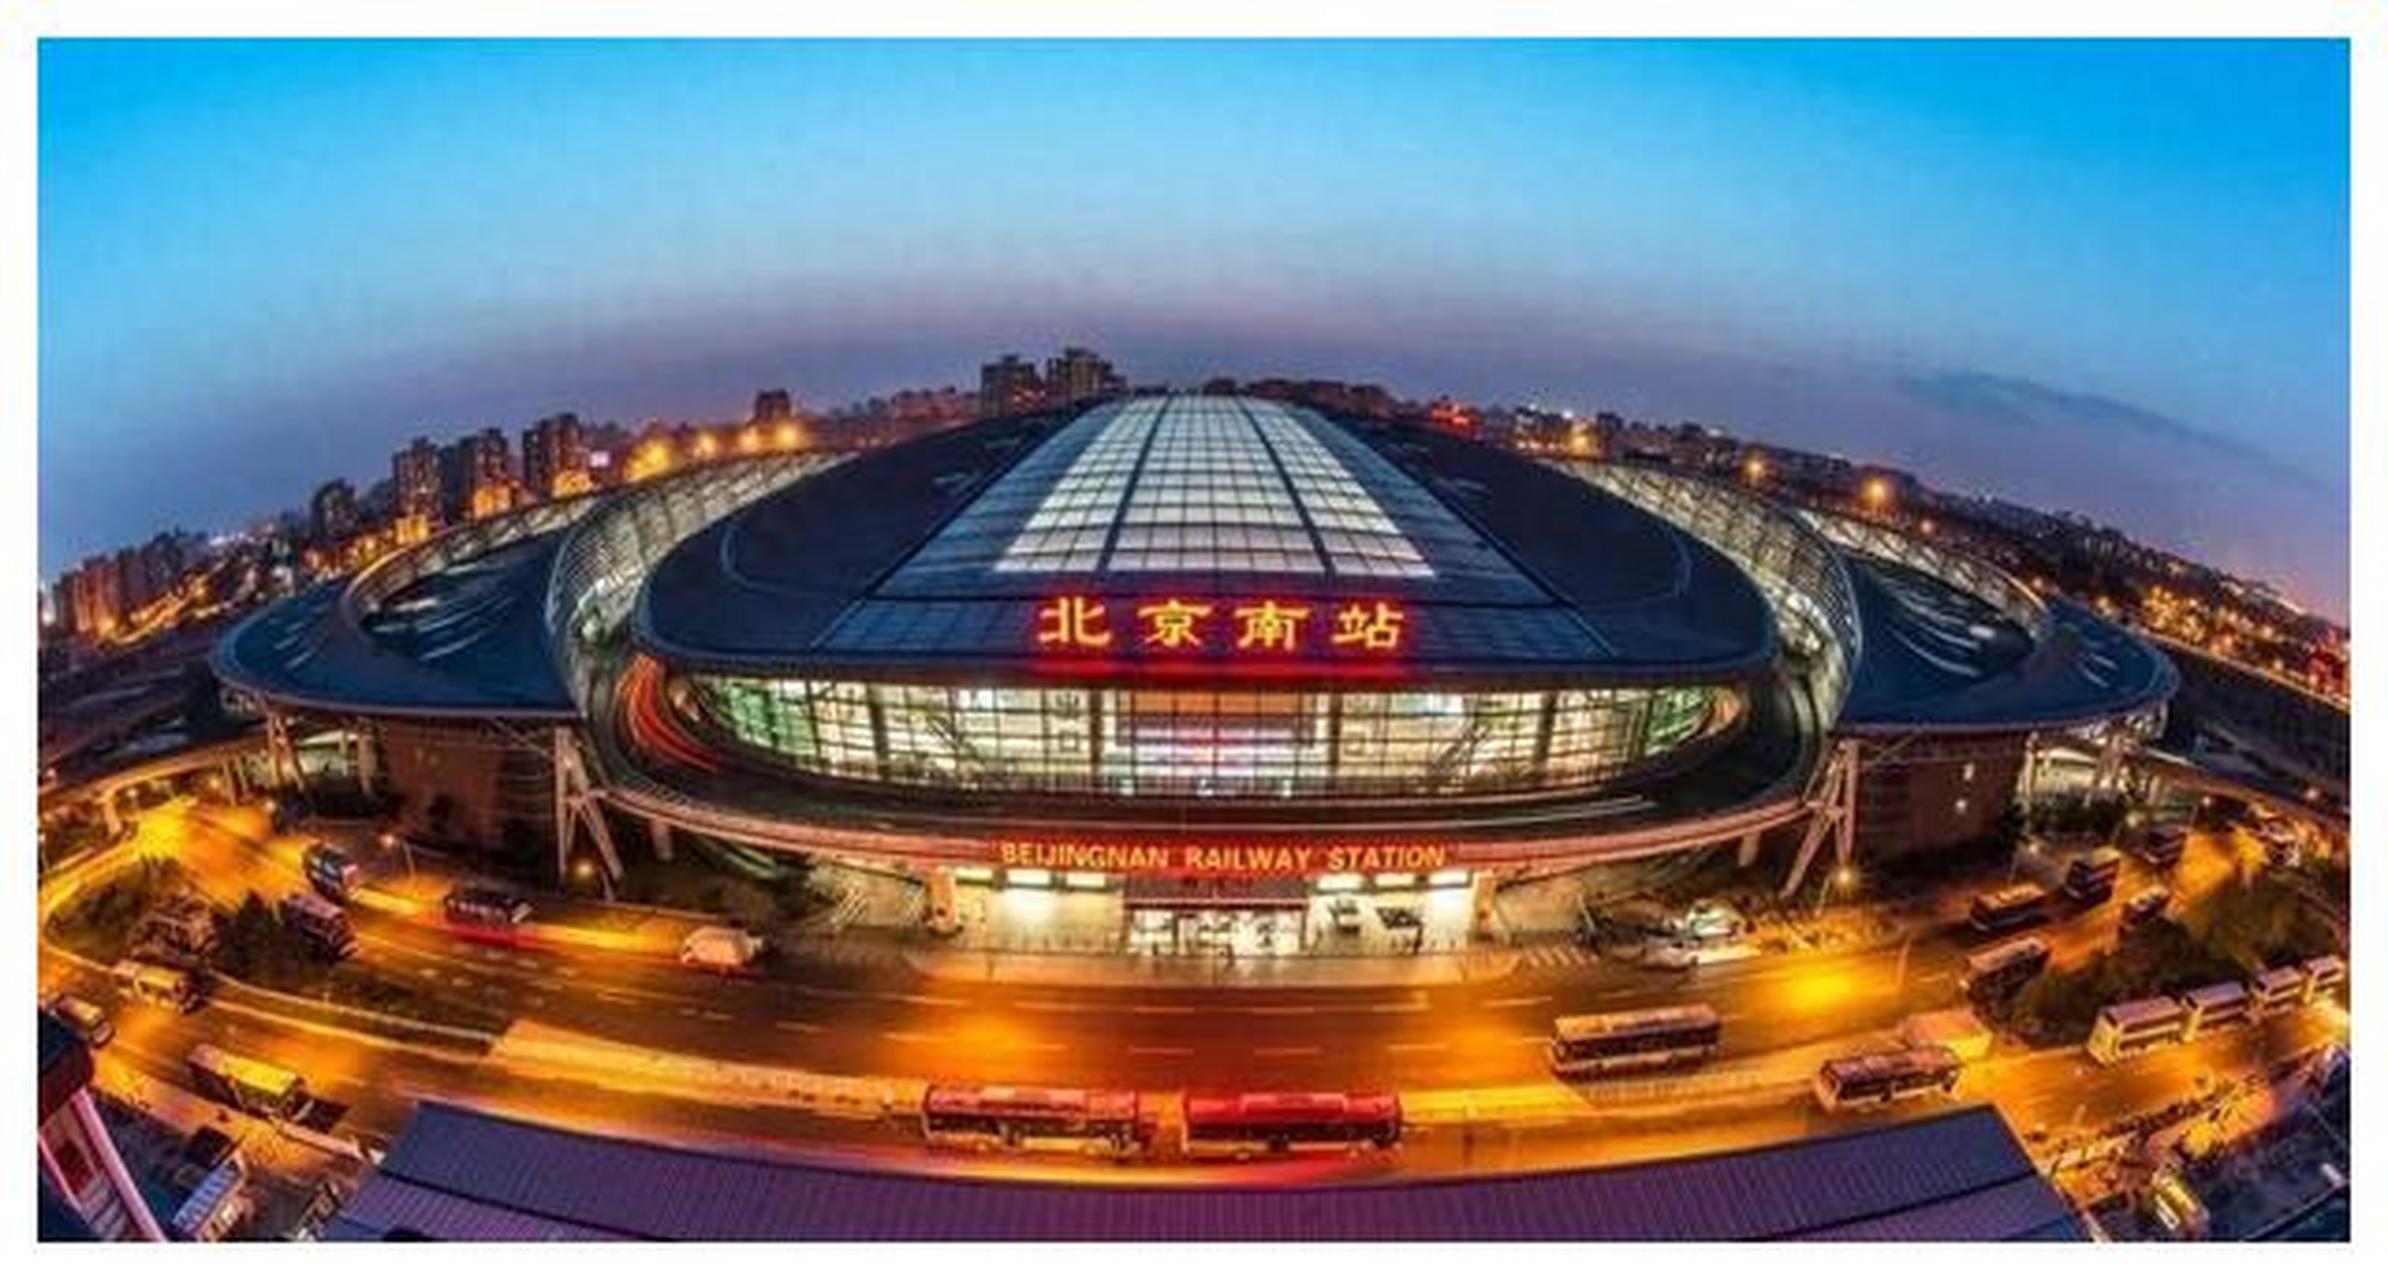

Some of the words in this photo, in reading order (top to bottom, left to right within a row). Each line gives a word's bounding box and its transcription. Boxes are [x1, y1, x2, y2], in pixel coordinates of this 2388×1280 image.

[1038, 597, 1404, 649] 北京南站
[1001, 843, 1169, 868] BEIJINGNAN
[1187, 846, 1310, 870] RAILWAY
[1328, 845, 1446, 870] STATION
